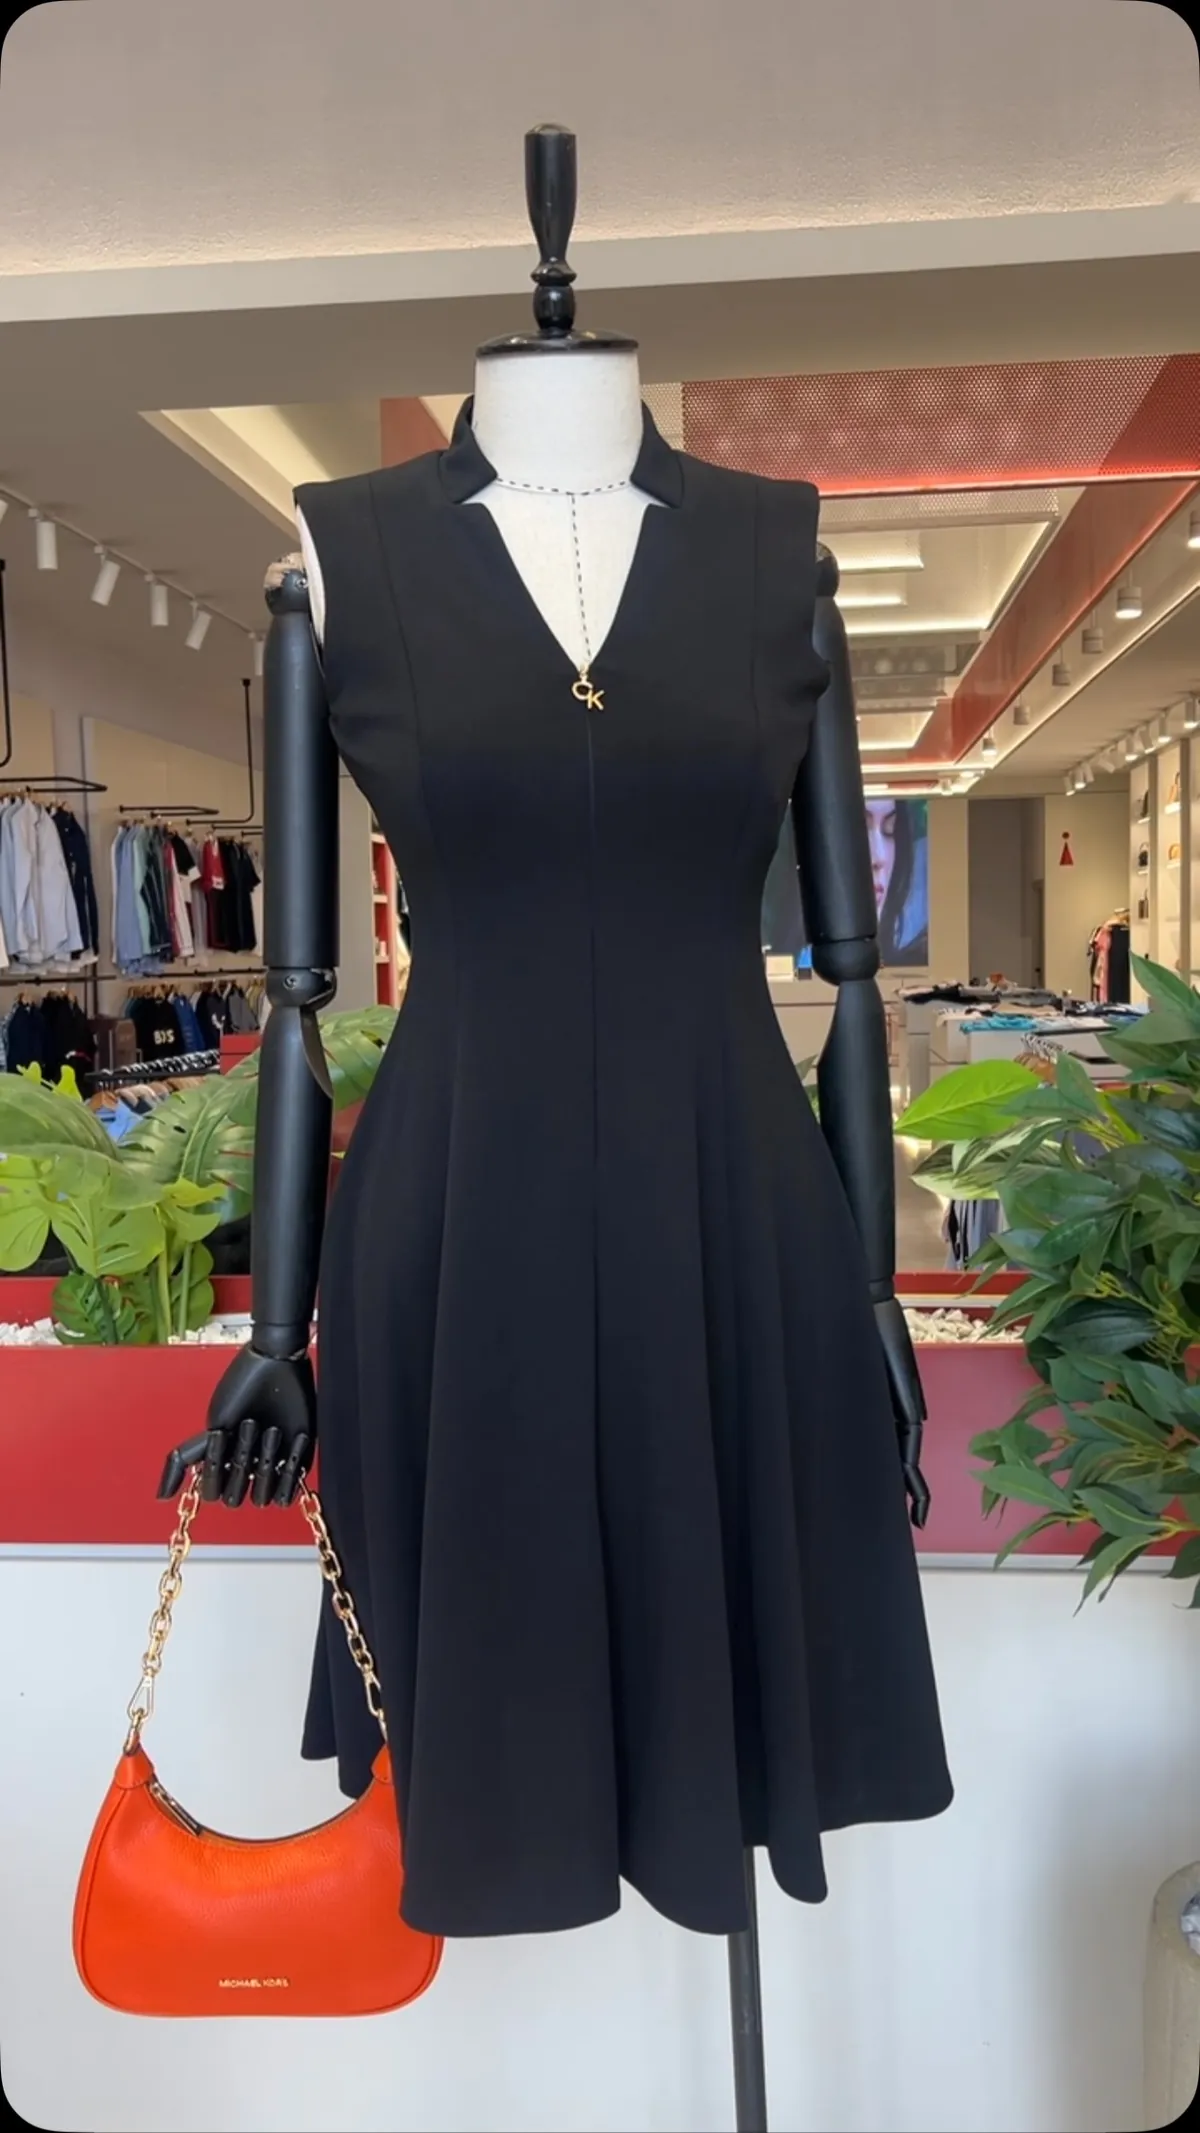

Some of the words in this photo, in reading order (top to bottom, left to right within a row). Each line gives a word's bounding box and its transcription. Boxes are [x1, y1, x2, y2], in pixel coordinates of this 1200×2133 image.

[571, 681, 605, 711] CK
[218, 1979, 262, 1988] MICHAEL
[263, 1978, 289, 1988] KORS
